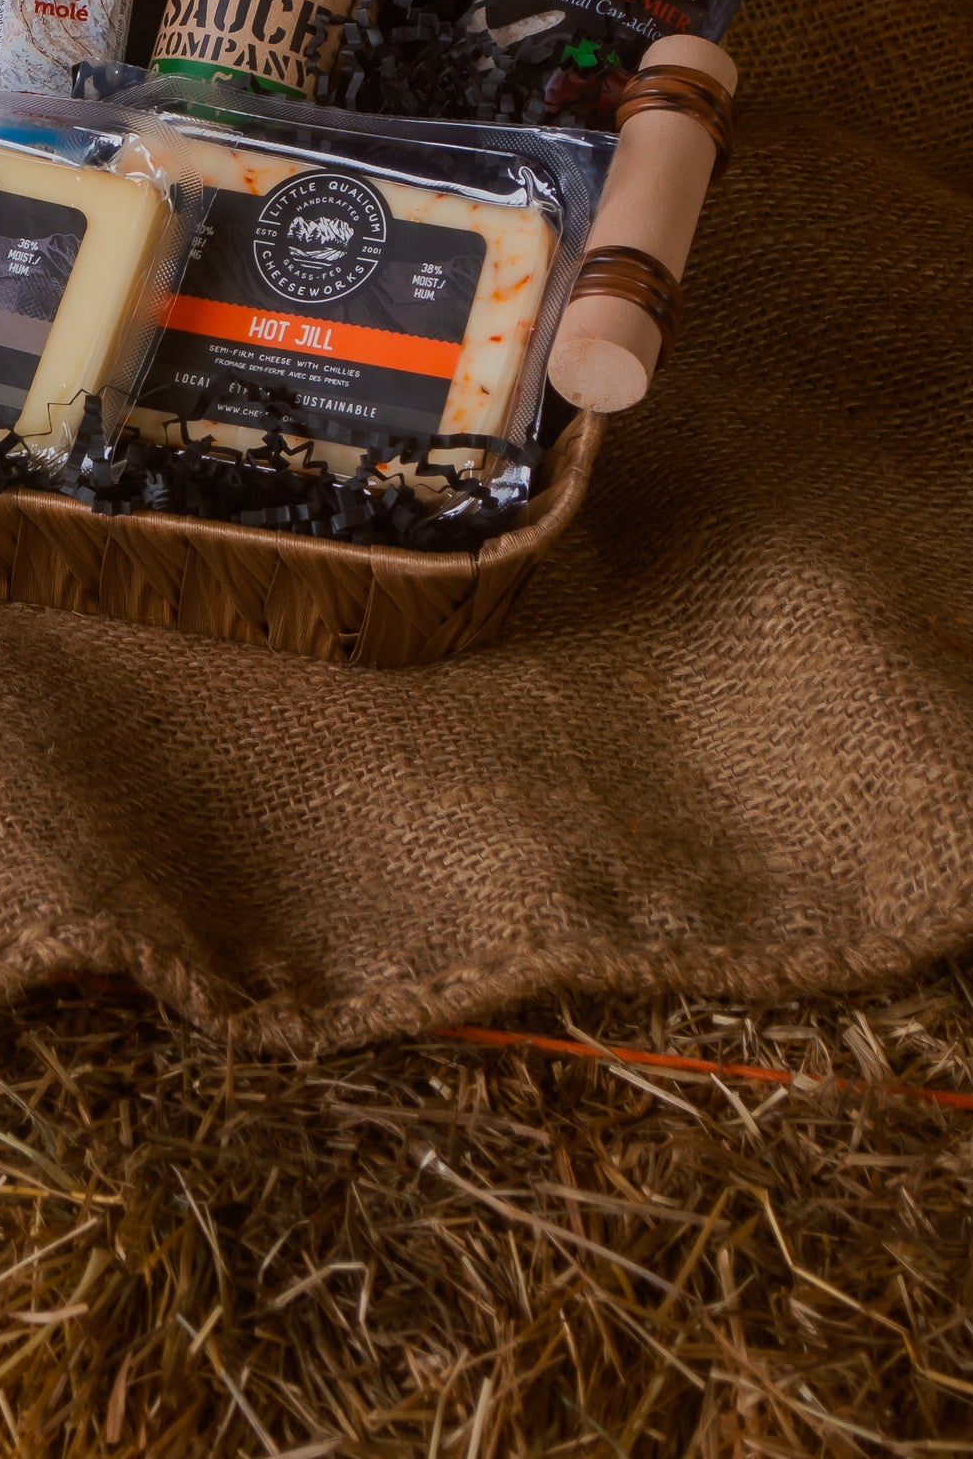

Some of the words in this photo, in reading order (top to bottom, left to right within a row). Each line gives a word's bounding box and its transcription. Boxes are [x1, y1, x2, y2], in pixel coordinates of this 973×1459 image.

[34, 0, 88, 22] molé
[154, 30, 310, 89] COMPANY
[269, 182, 316, 217] LITTLE
[328, 181, 381, 233] QUALICUM
[296, 196, 360, 222] HANDCRAFTED
[17, 238, 39, 251] 36%
[256, 227, 278, 237] ESTD
[362, 246, 381, 255] 2001
[8, 262, 30, 276] HUM.
[262, 250, 364, 297] CHEESEWORKS
[283, 259, 342, 281] GRASS-FED
[421, 262, 443, 275] 38%
[413, 287, 435, 301] HUM.
[248, 316, 291, 342] HOT
[295, 324, 333, 351] JILL
[209, 344, 255, 359] SEMI-FIRM
[259, 354, 292, 366] CHEESE
[297, 360, 319, 370] WITH
[323, 364, 361, 378] CHILLIES
[214, 358, 248, 370] FROMAGE
[249, 364, 285, 377] DEMI-FERME
[288, 371, 307, 380] AVEC
[309, 373, 322, 382] DES
[324, 376, 350, 387] PIMENTS
[295, 393, 377, 419] SUSTAINABLE
